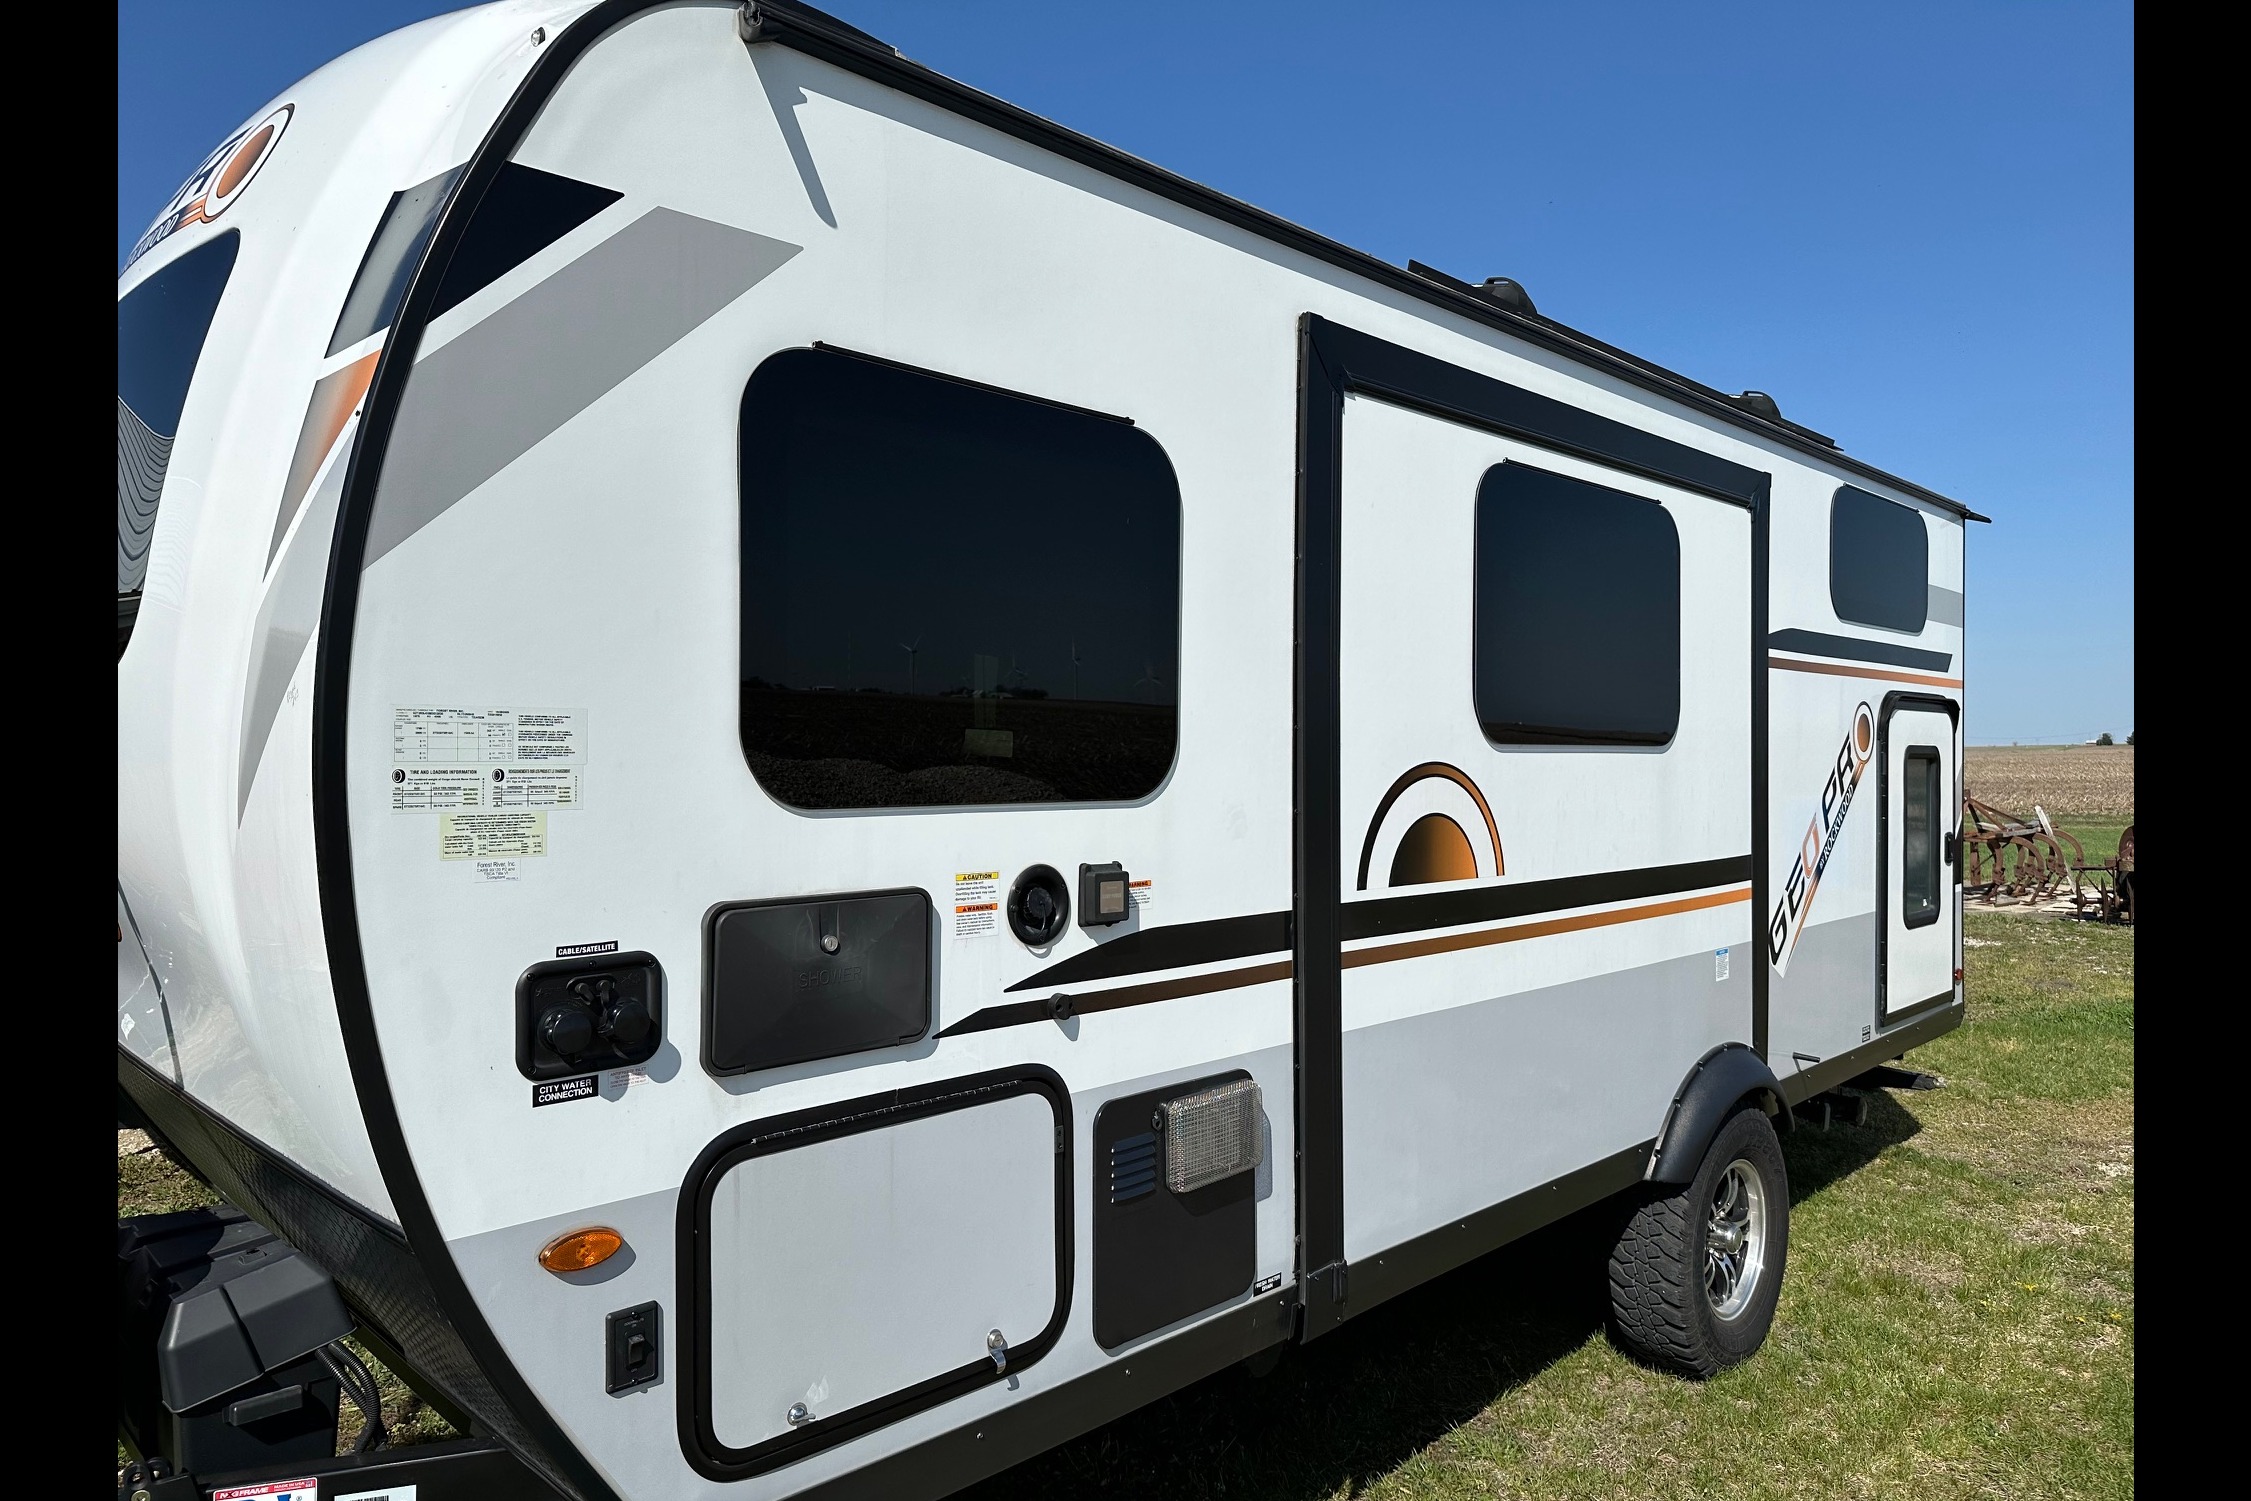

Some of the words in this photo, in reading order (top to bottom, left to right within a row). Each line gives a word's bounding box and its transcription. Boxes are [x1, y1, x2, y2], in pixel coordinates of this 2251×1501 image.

[1823, 784, 1854, 862] ROCKWOOD
[1768, 812, 1820, 966] GEO
[558, 943, 616, 956] CABLE/SATELLITE
[800, 966, 862, 988] SHOWER
[538, 1087, 593, 1103] CONNECTION
[539, 1084, 559, 1094] CITY
[562, 1079, 592, 1090] WATER
